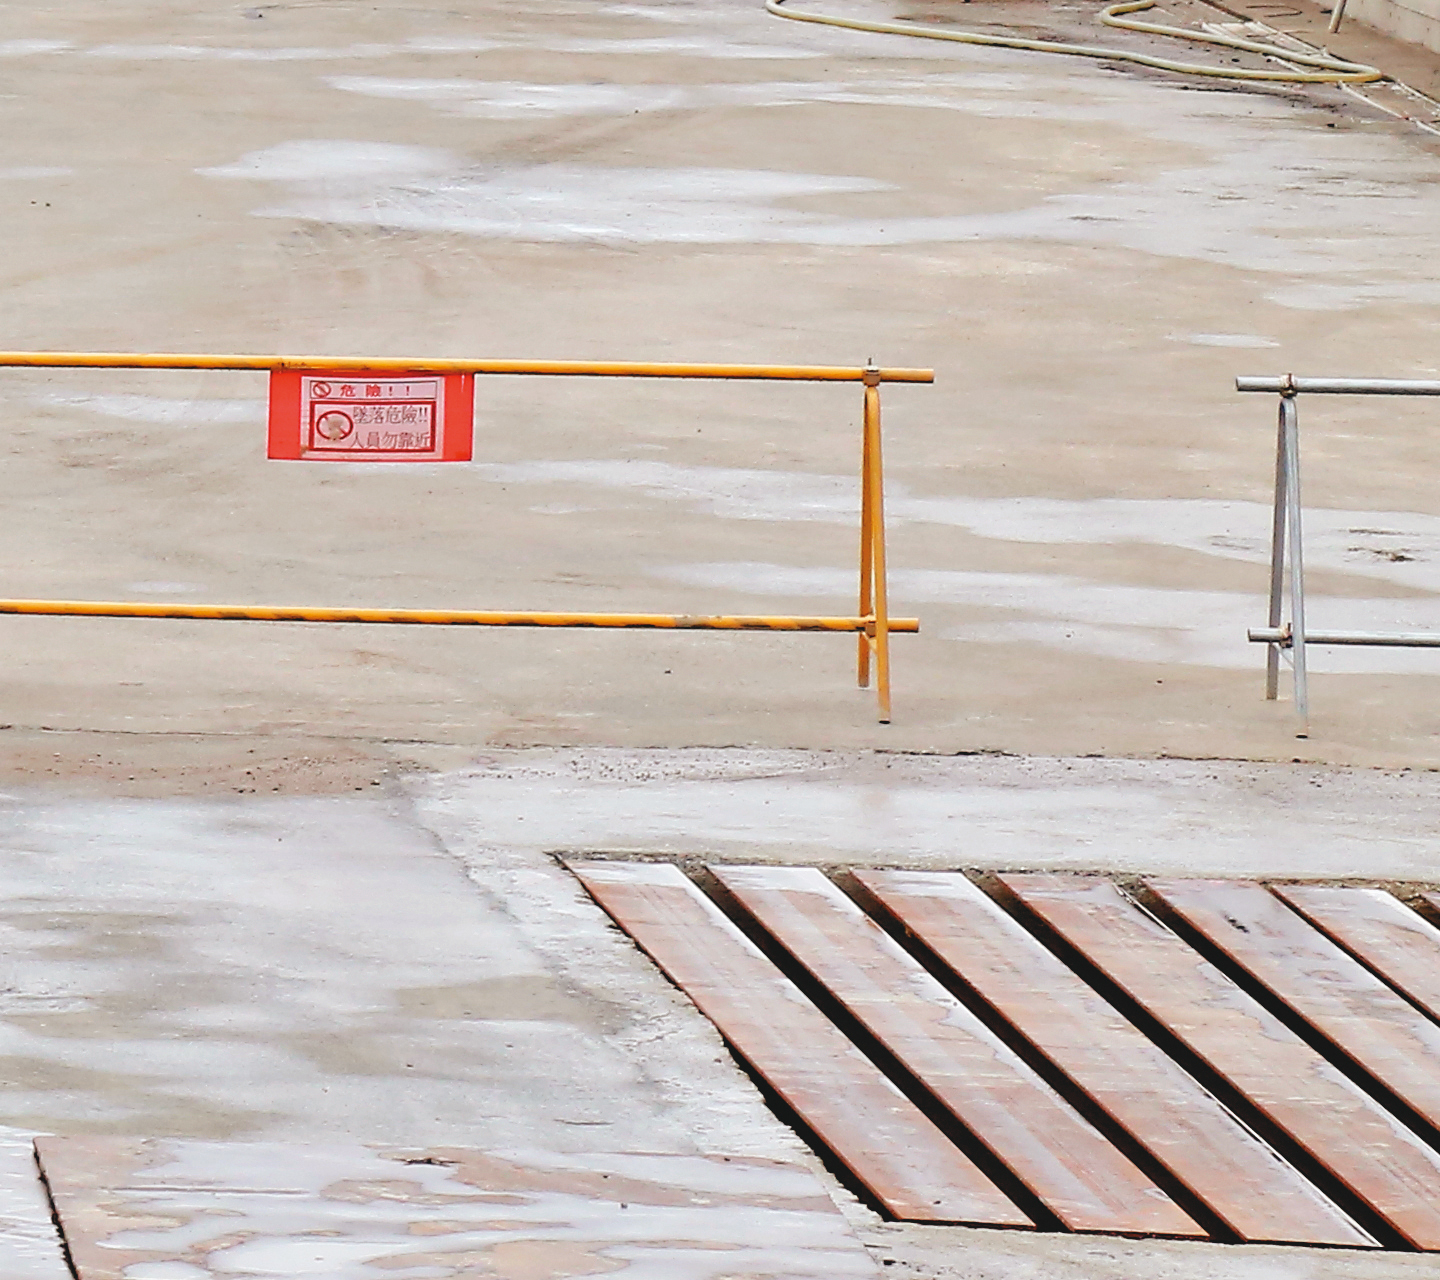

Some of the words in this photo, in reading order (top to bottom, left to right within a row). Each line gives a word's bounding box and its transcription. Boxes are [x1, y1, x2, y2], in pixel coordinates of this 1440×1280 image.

[349, 431, 430, 449] 人員勿靠近
